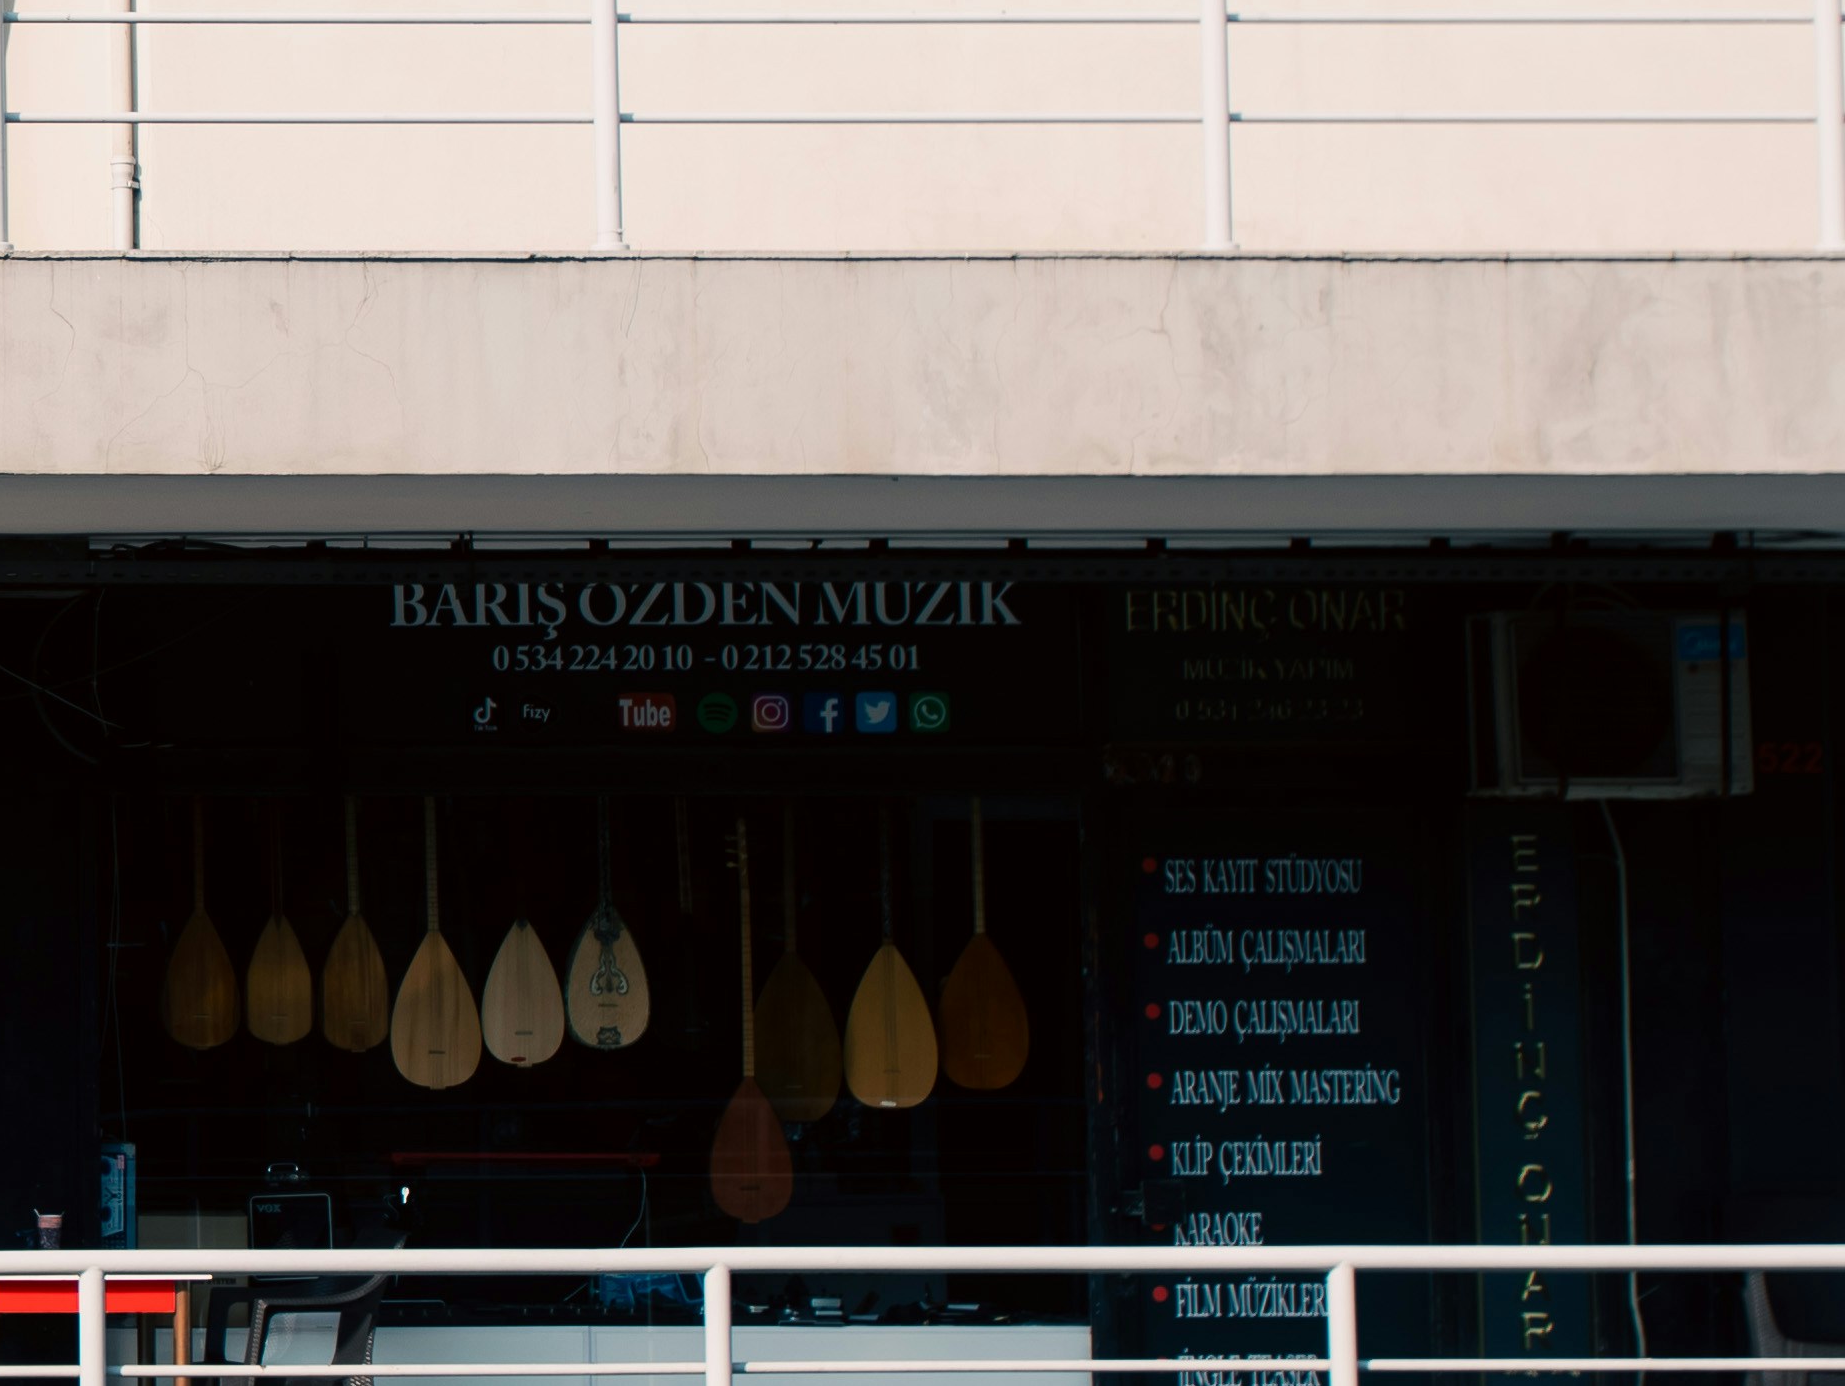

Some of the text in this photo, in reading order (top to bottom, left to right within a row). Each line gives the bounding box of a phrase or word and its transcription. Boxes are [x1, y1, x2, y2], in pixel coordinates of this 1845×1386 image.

[1287, 588, 1406, 631] ONAR
[493, 646, 509, 670] 0
[515, 646, 565, 670] 534
[568, 646, 619, 670] 224
[622, 646, 655, 670] 20
[662, 646, 693, 670] 10
[721, 646, 737, 670] 0
[743, 646, 792, 670] 212
[797, 645, 847, 670] 528
[851, 645, 884, 670] 45
[888, 645, 921, 670] 01
[618, 697, 672, 727] Tube
[1165, 854, 1362, 894] SES KAYIT STÜDYOSU
[1167, 924, 1367, 973] ALBÜM ÇALIŞMALARI
[1169, 999, 1361, 1044] DEMO ÇALIŞMALARI
[1170, 1063, 1401, 1114] ARANJE MİX MASTERİNG
[1171, 1134, 1322, 1185] KLİP ÇEKİMLERİ
[1174, 1212, 1264, 1246] KARAOKE
[1176, 1276, 1222, 1318] FİLM
